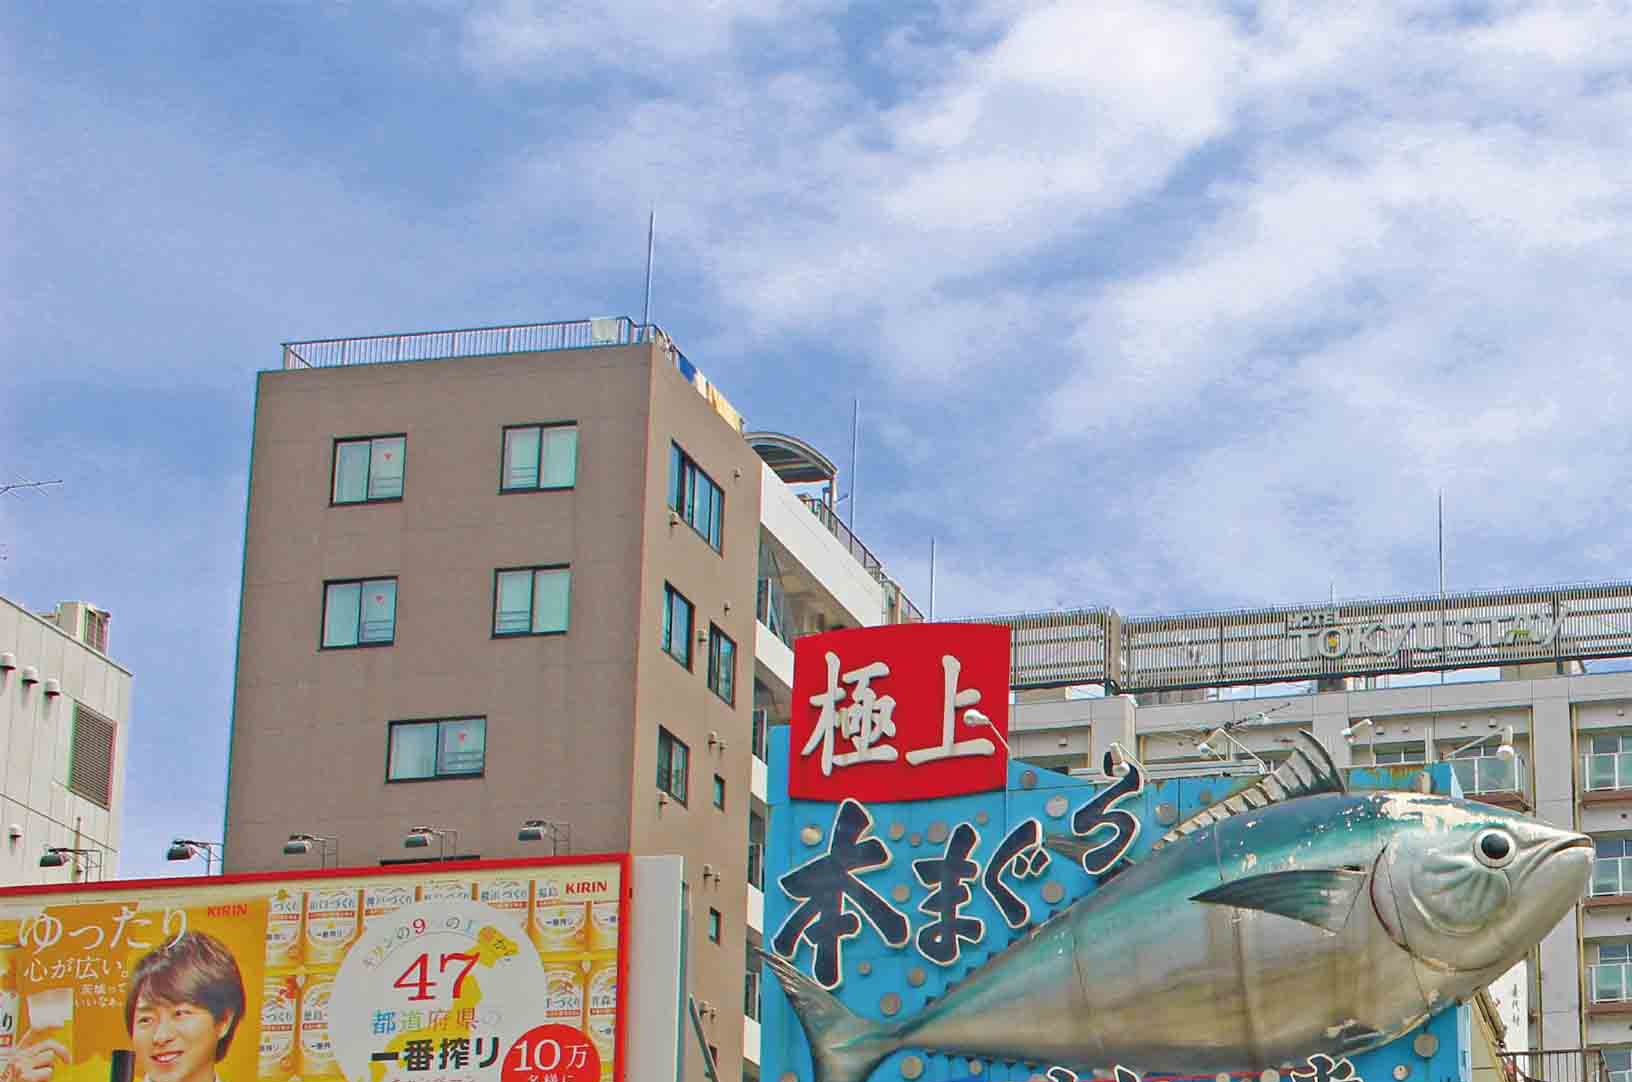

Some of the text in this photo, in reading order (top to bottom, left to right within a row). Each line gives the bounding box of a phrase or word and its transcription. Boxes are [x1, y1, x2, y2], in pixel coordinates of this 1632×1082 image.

[1288, 602, 1571, 661] TOKYU STAY
[801, 651, 997, 776] 極上
[566, 881, 608, 895] KIRIN
[771, 742, 1145, 990] 本まぐろ
[17, 904, 189, 955] ゆったり
[207, 903, 248, 918] KIRIN
[393, 952, 481, 1001] 47
[371, 1036, 500, 1071] 一番搾り
